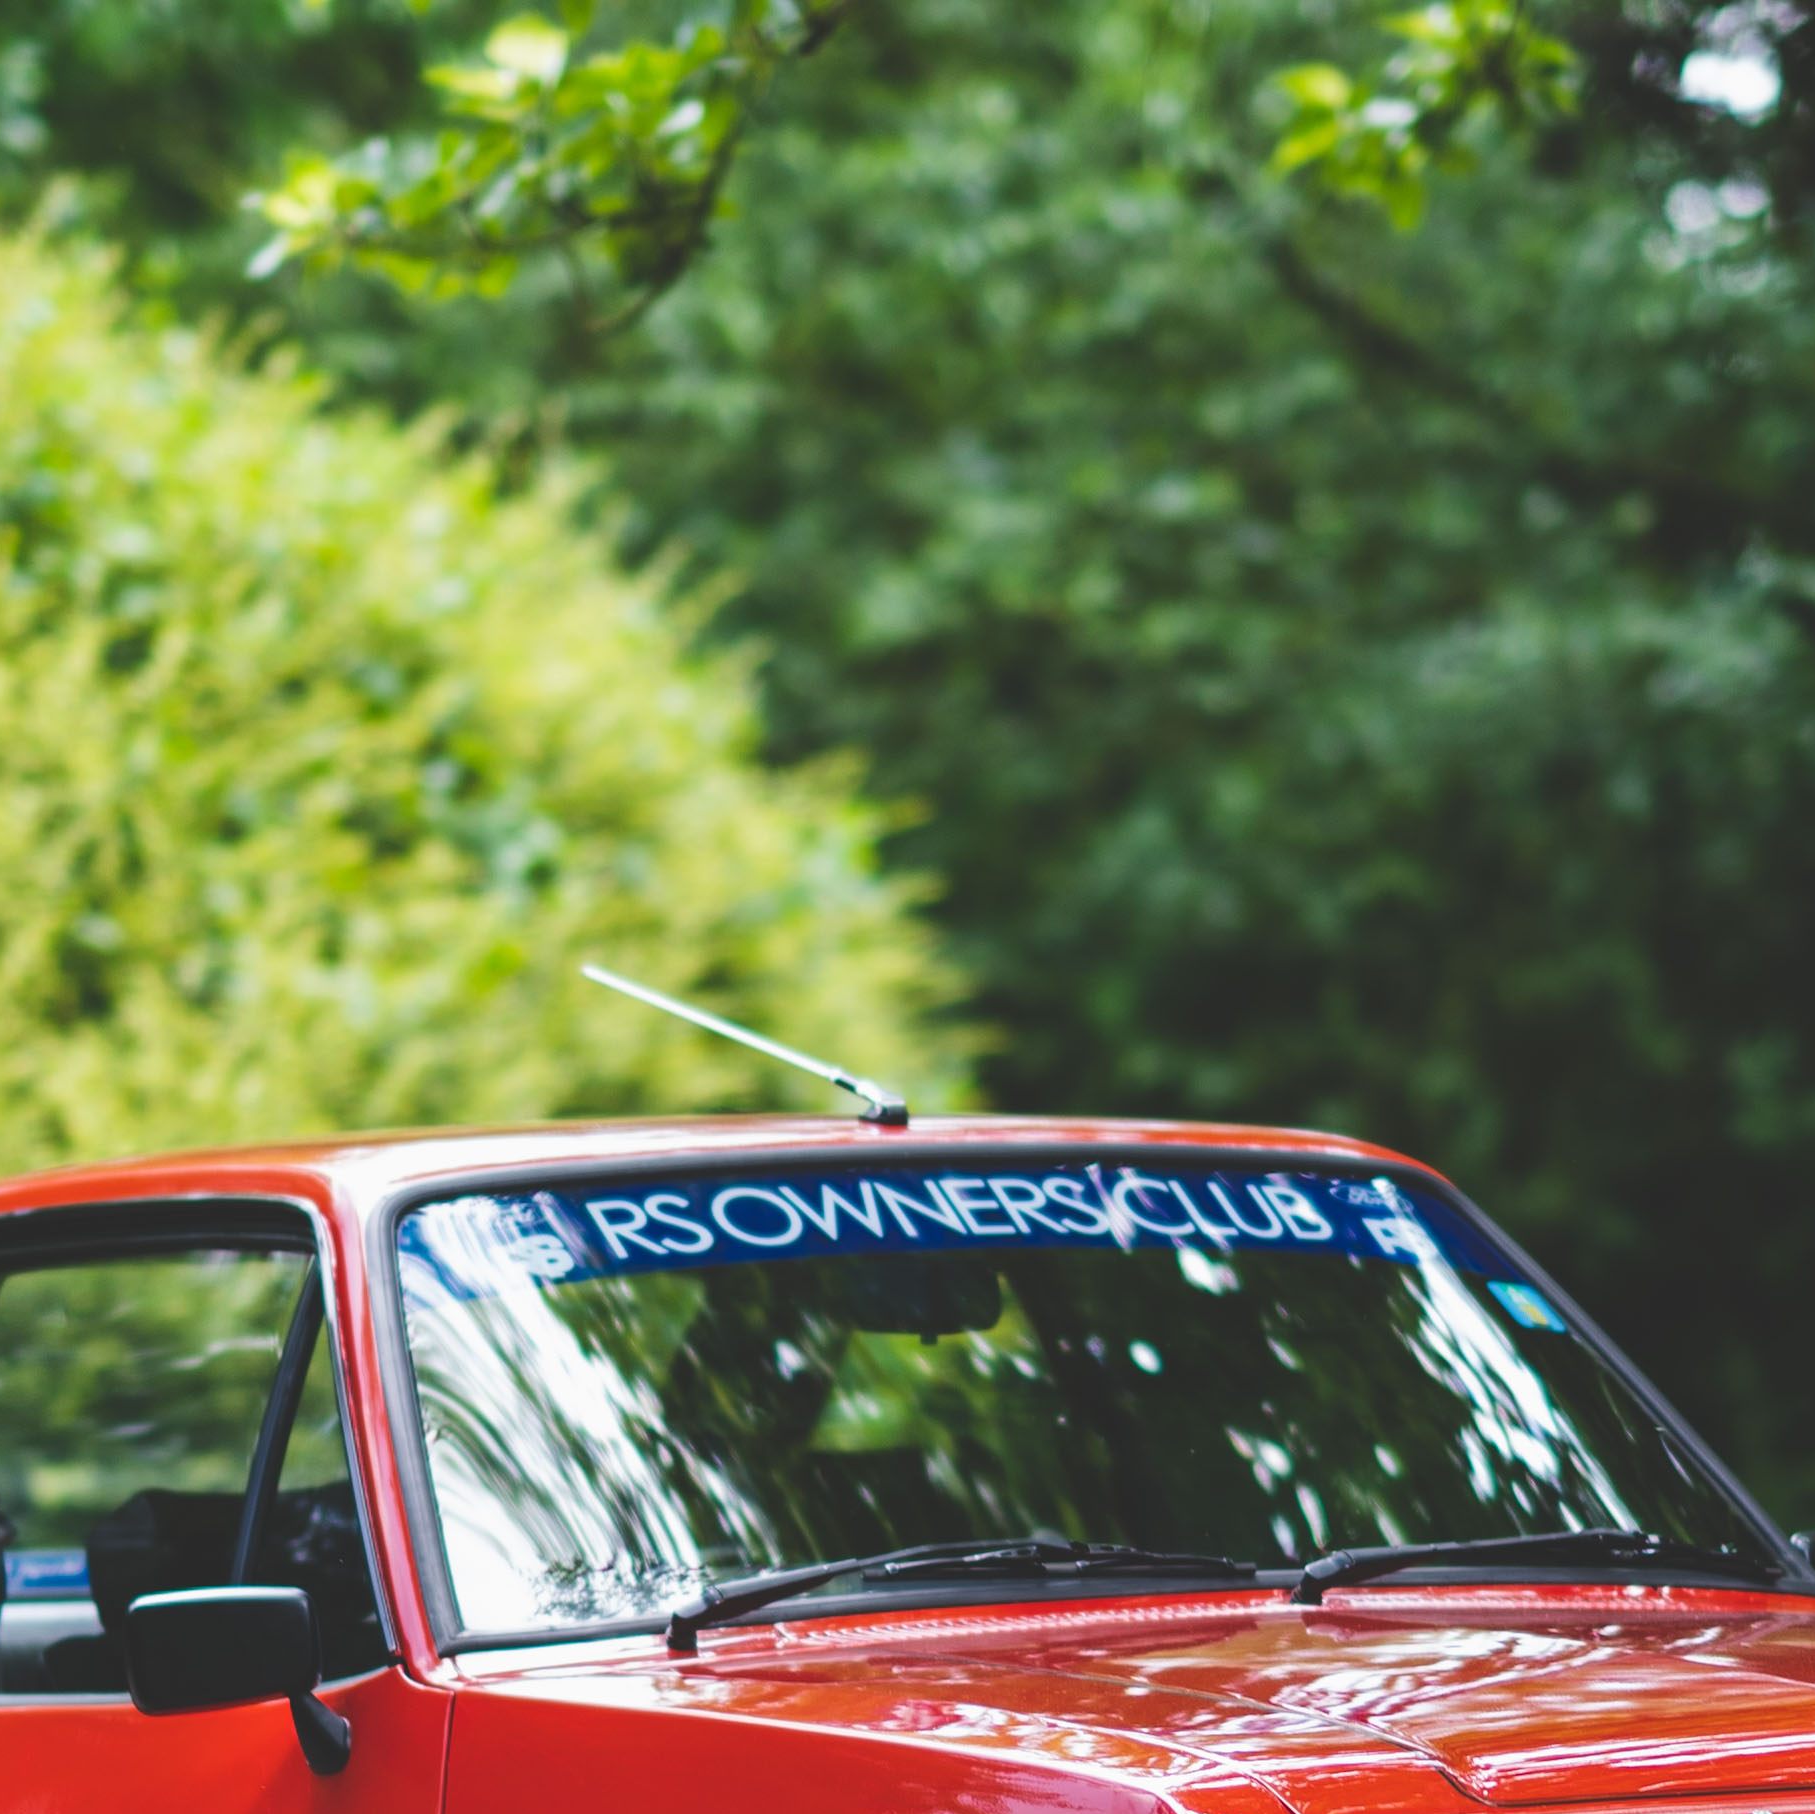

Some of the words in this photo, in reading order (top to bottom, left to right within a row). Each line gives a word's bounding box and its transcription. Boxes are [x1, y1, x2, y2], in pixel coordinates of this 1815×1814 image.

[586, 1194, 715, 1259] RS
[711, 1177, 1110, 1247] OWNERS
[1112, 1177, 1334, 1241] CLUB
